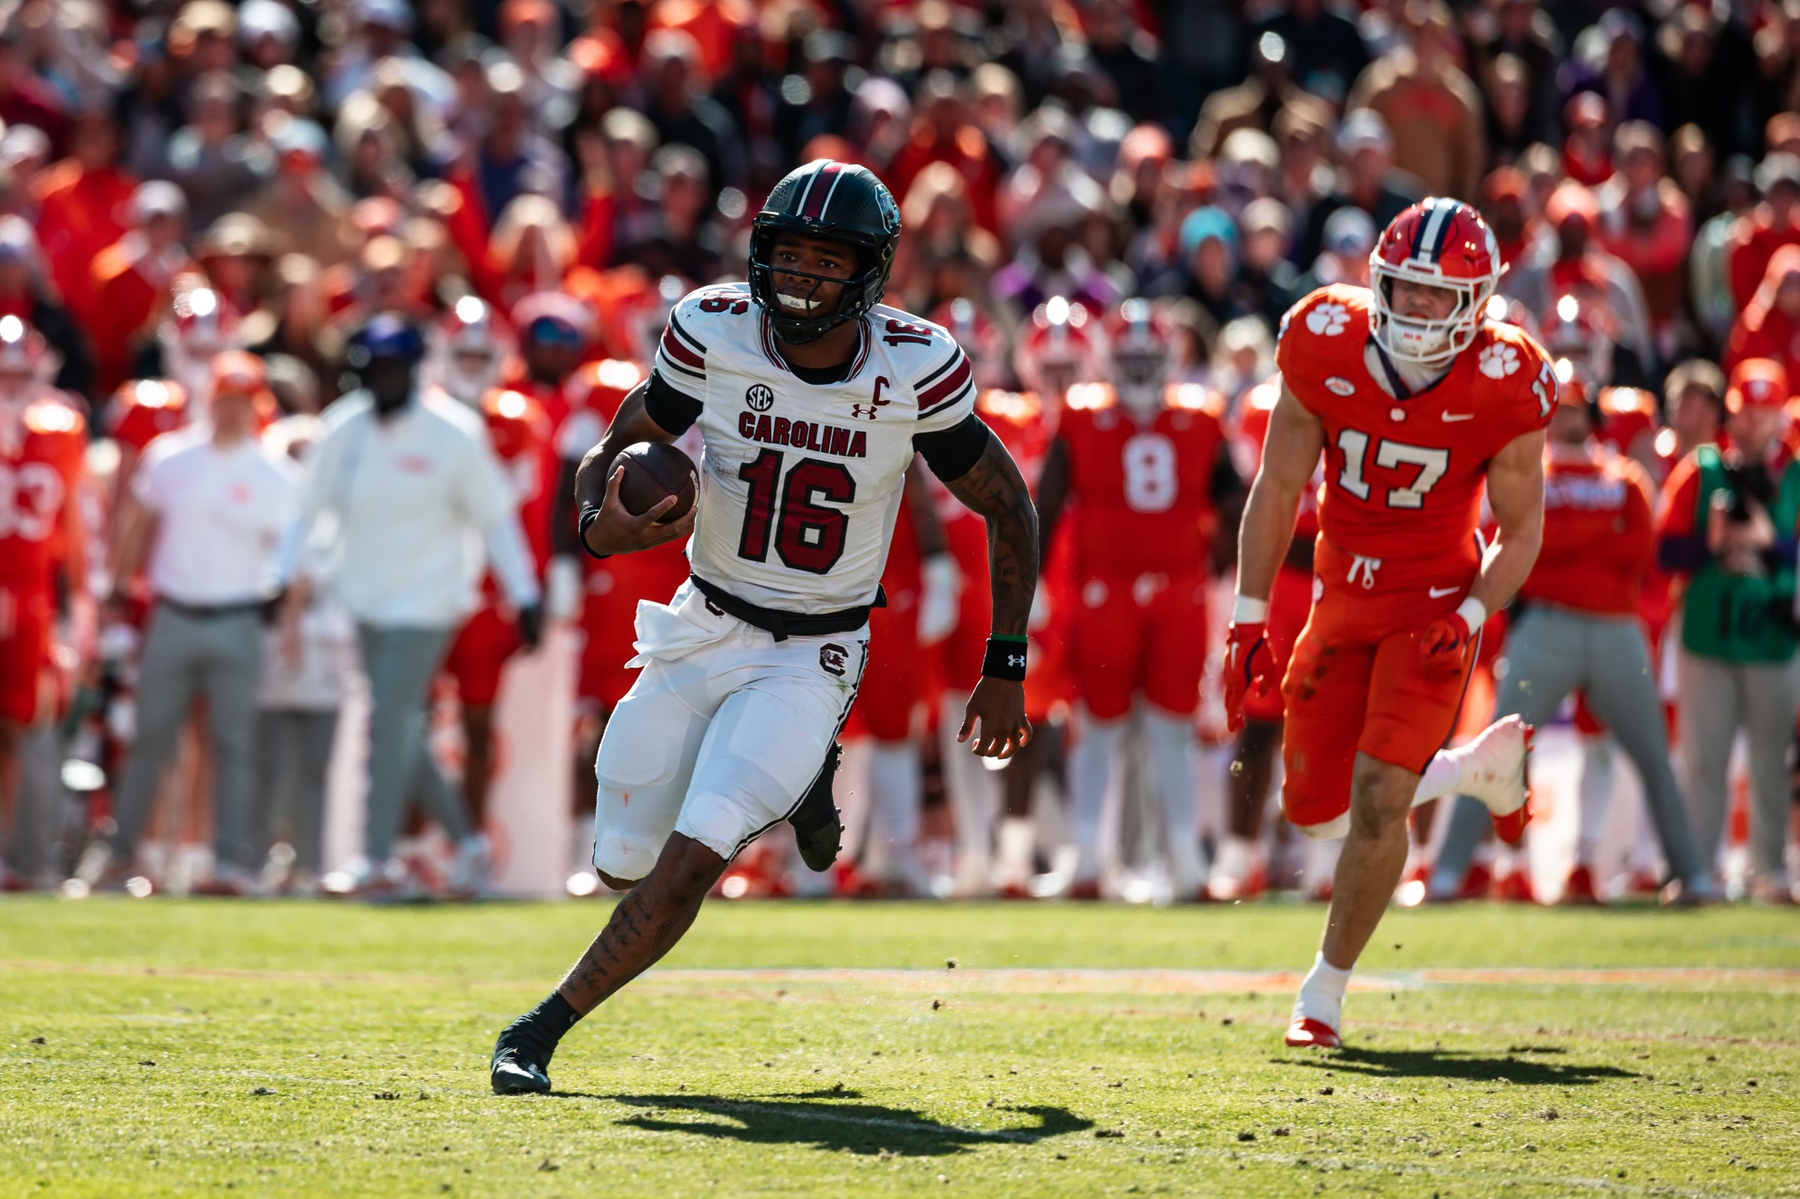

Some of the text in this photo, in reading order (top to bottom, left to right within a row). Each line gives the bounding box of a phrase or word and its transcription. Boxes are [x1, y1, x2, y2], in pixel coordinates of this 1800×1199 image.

[882, 318, 933, 347] 16
[748, 386, 771, 410] SEC
[872, 375, 891, 406] C
[738, 411, 867, 458] CAROLINA
[1121, 433, 1179, 514] 8
[1337, 427, 1451, 510] 17
[0, 461, 64, 541] 3
[737, 447, 857, 575] 16
